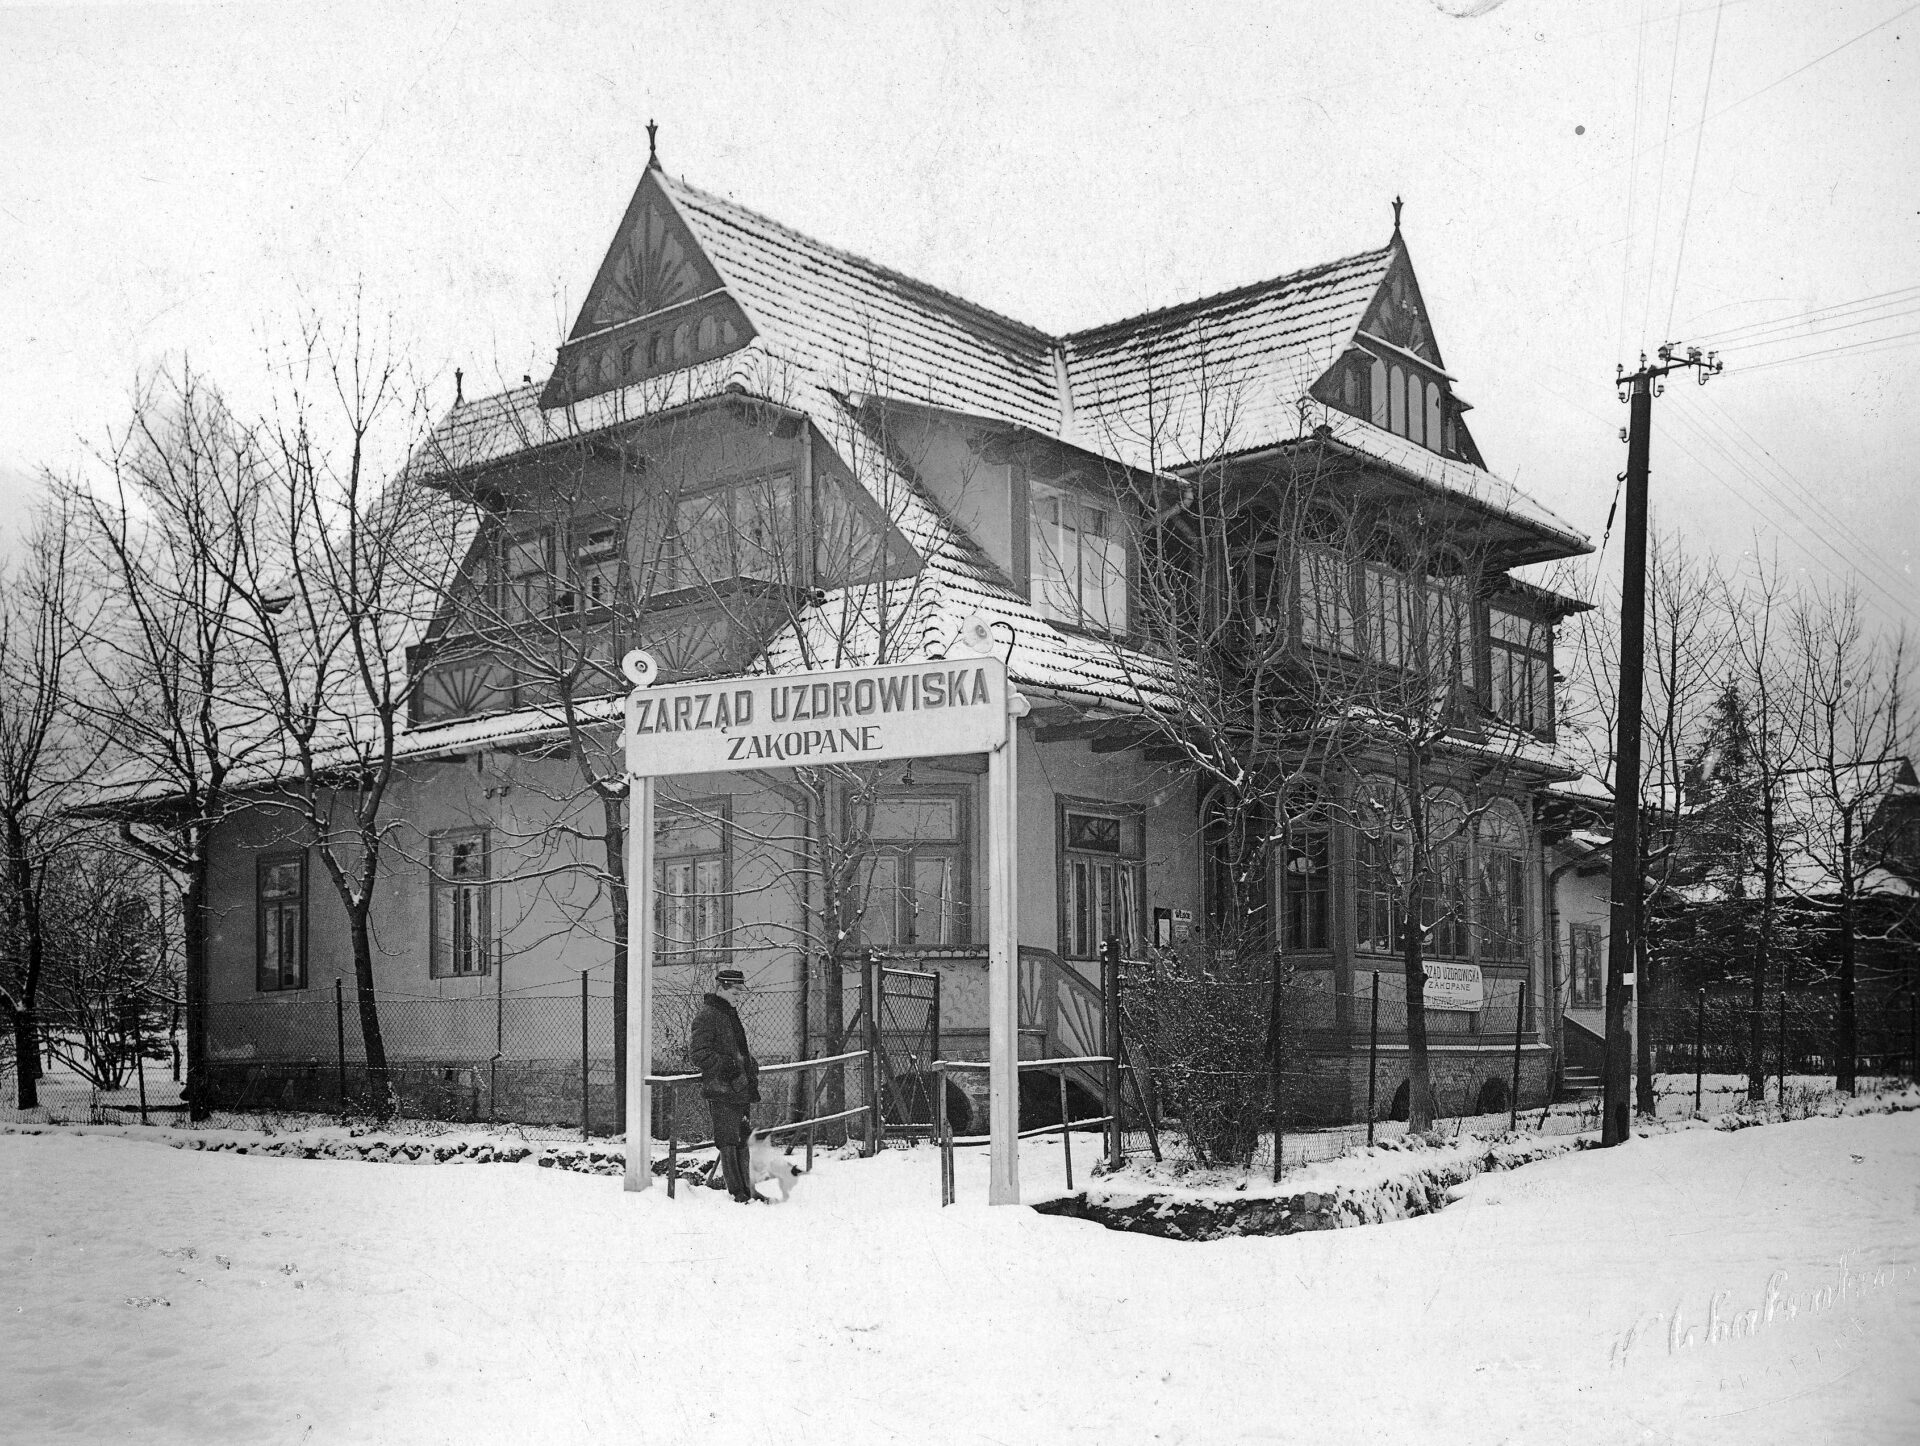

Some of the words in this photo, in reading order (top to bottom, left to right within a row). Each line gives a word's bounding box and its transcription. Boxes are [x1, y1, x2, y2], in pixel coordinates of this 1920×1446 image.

[635, 689, 756, 736] ZARZĄD
[770, 667, 992, 724] UZDROWISKA
[726, 725, 884, 762] ZAKOPANE
